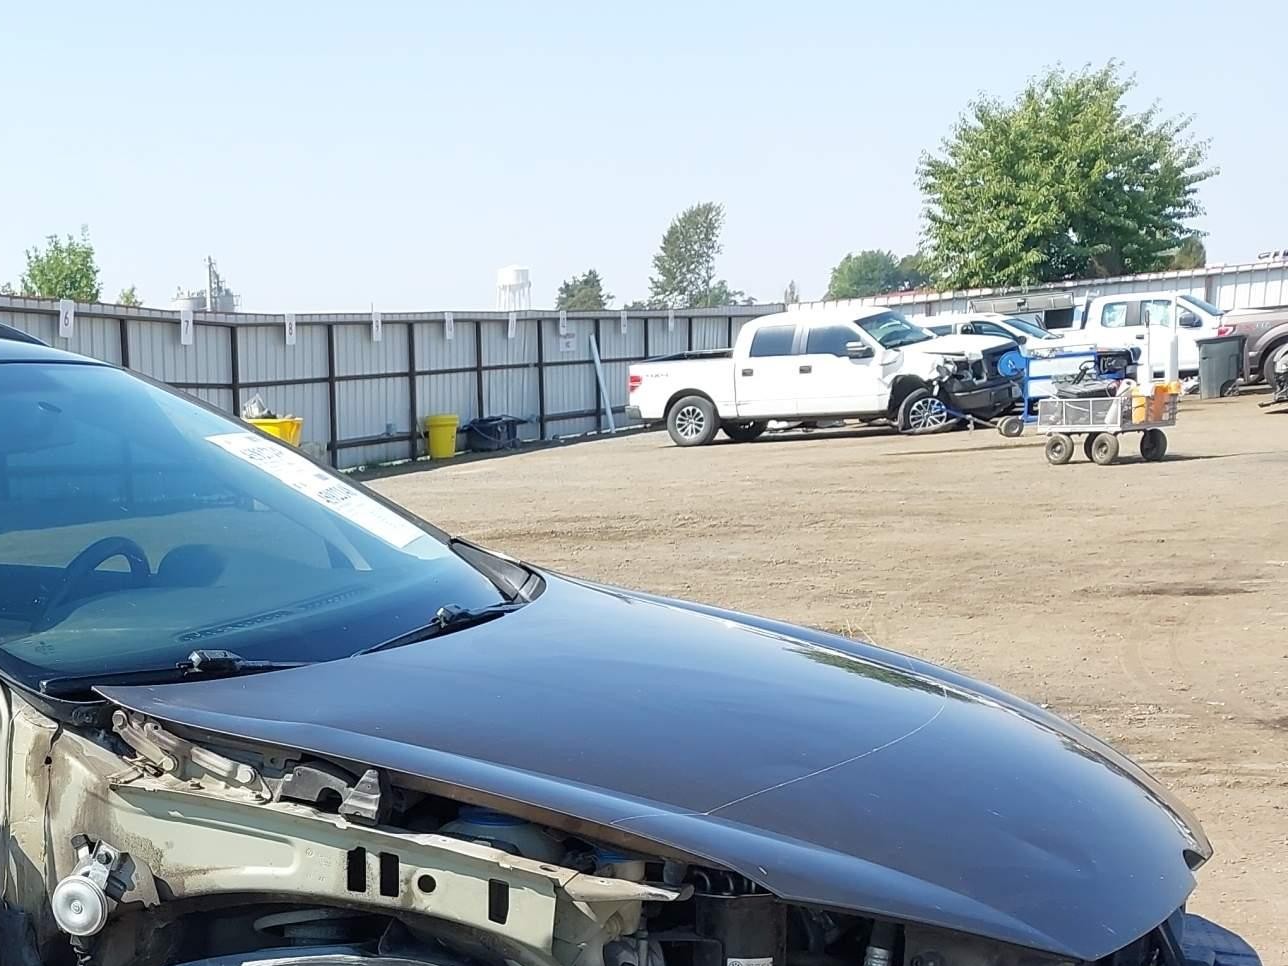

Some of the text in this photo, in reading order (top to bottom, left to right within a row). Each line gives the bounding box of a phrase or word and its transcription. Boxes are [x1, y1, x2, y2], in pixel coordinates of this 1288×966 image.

[63, 311, 70, 327] 6
[184, 319, 190, 335] 7
[288, 322, 294, 336] 8
